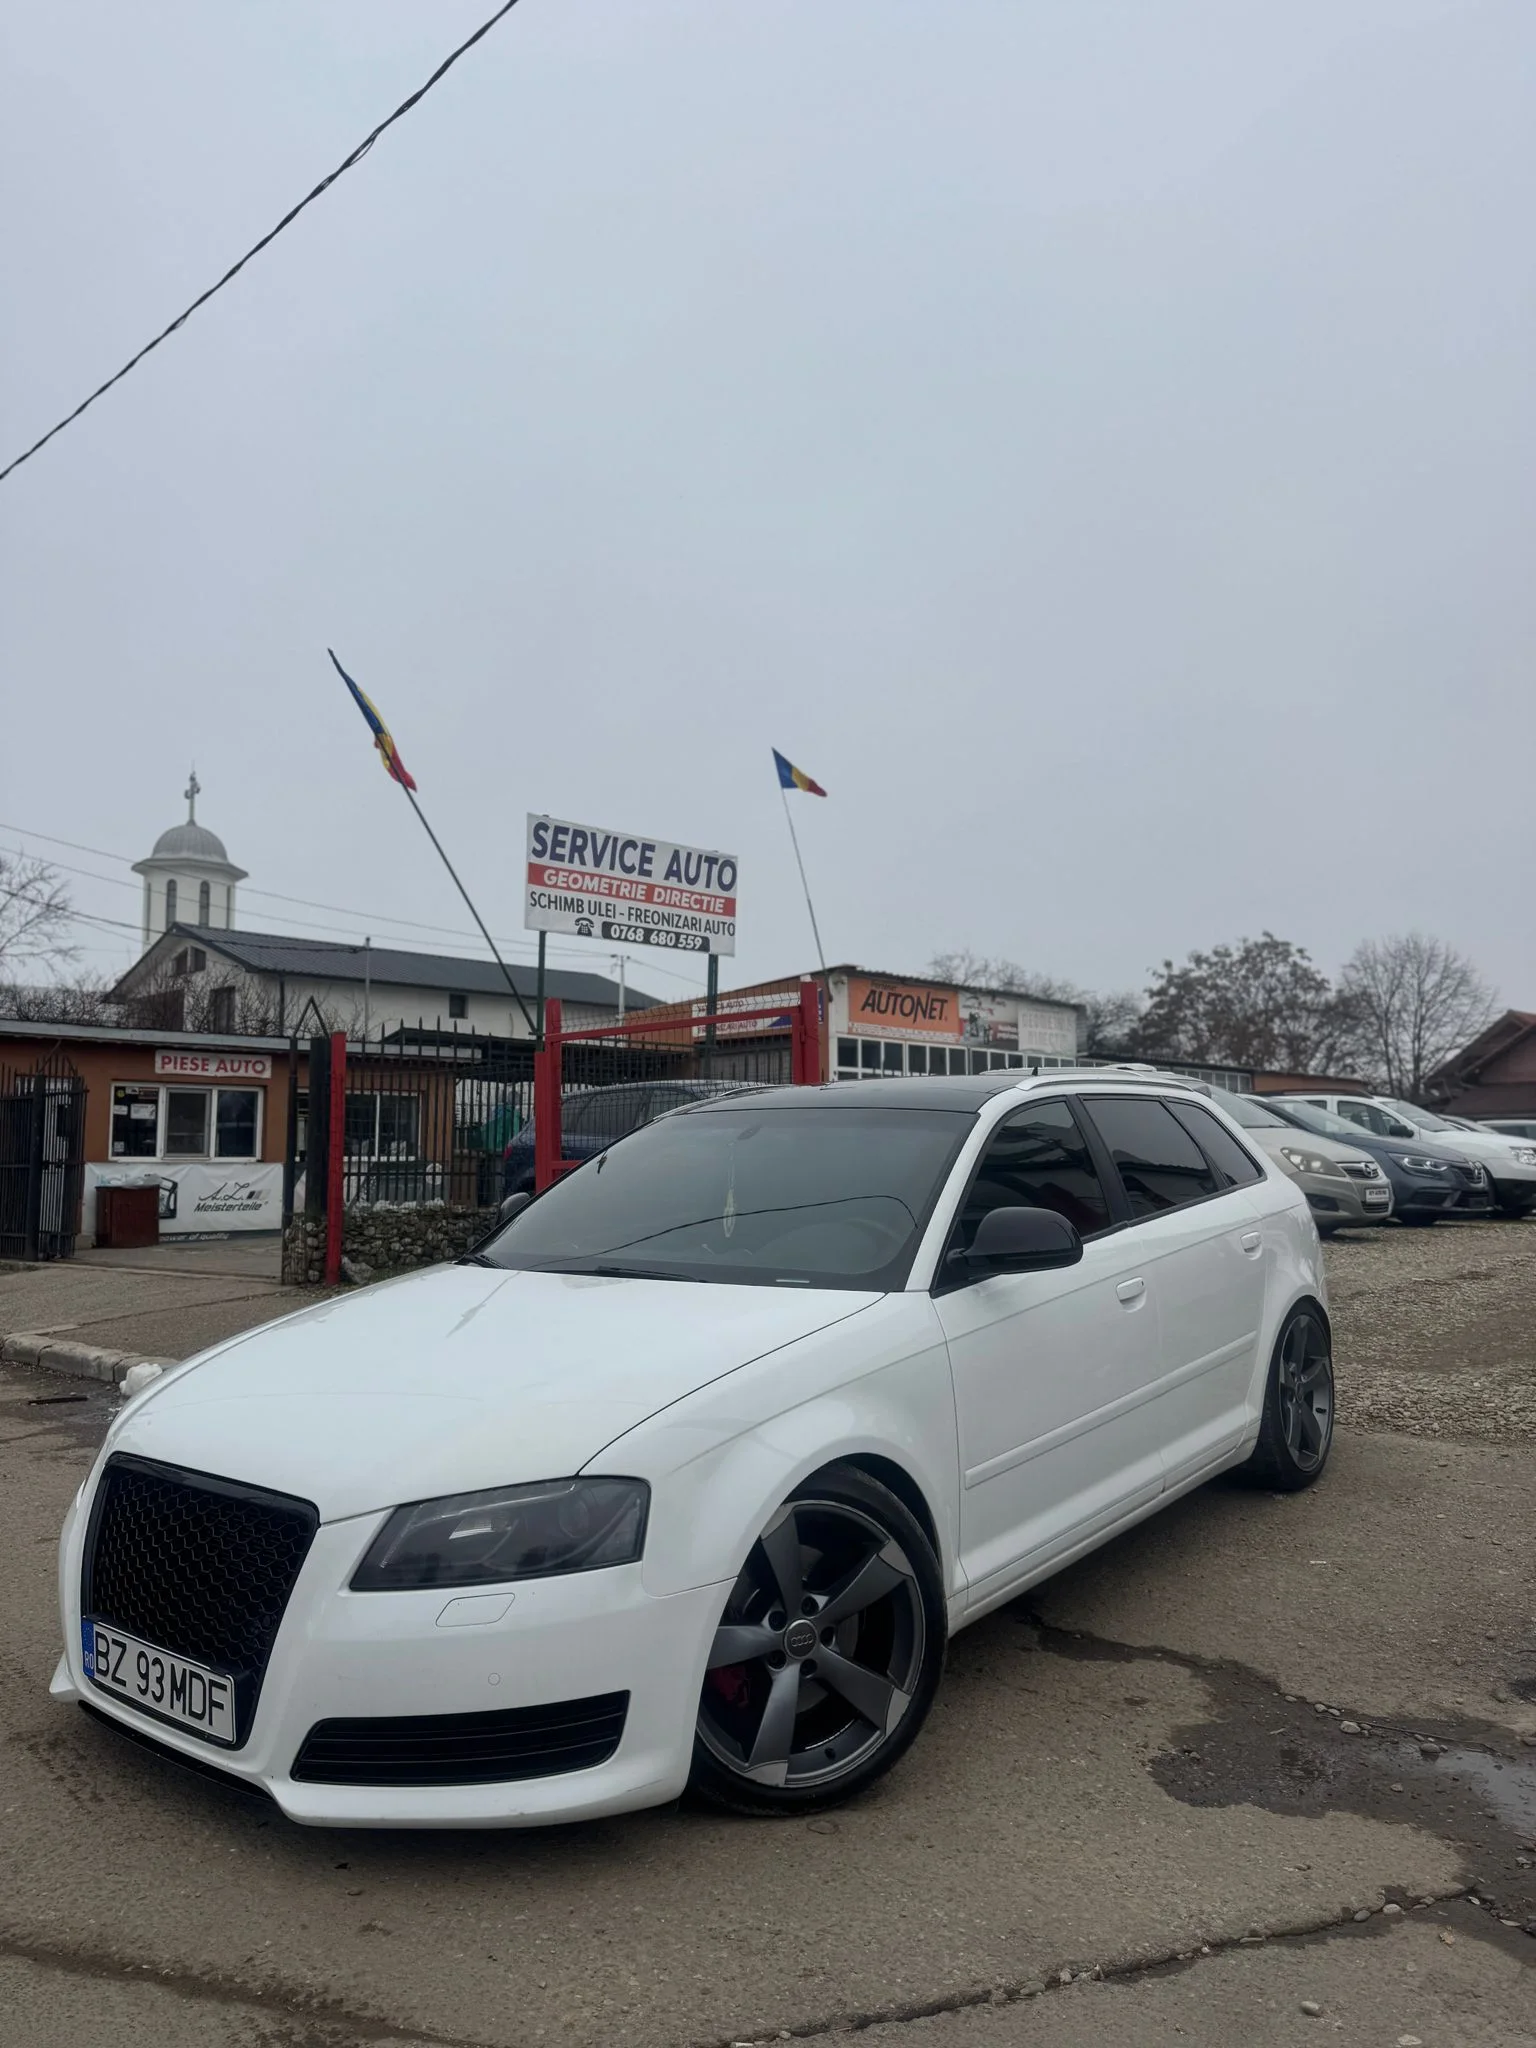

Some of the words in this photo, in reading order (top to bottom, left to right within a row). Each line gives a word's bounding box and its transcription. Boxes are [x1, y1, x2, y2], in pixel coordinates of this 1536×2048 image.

[531, 821, 656, 878] SERVICE
[664, 849, 737, 892] AUTO
[543, 869, 647, 900] GEOMETRIE
[653, 887, 725, 913] DIRECTIE
[530, 891, 585, 915] SCHIMB
[588, 900, 616, 919] ULEI
[628, 906, 702, 932] FREONIZARI
[704, 918, 736, 937] AUTO
[610, 925, 645, 942] 0768
[650, 930, 676, 947] 680
[678, 934, 703, 950] 559
[861, 989, 948, 1024] AUTONET
[161, 1055, 210, 1072] PIESE
[215, 1058, 266, 1074] AUTO
[84, 1651, 94, 1670] RO
[96, 1631, 127, 1688] BZ
[137, 1651, 165, 1703] 93
[170, 1663, 228, 1726] MDF
